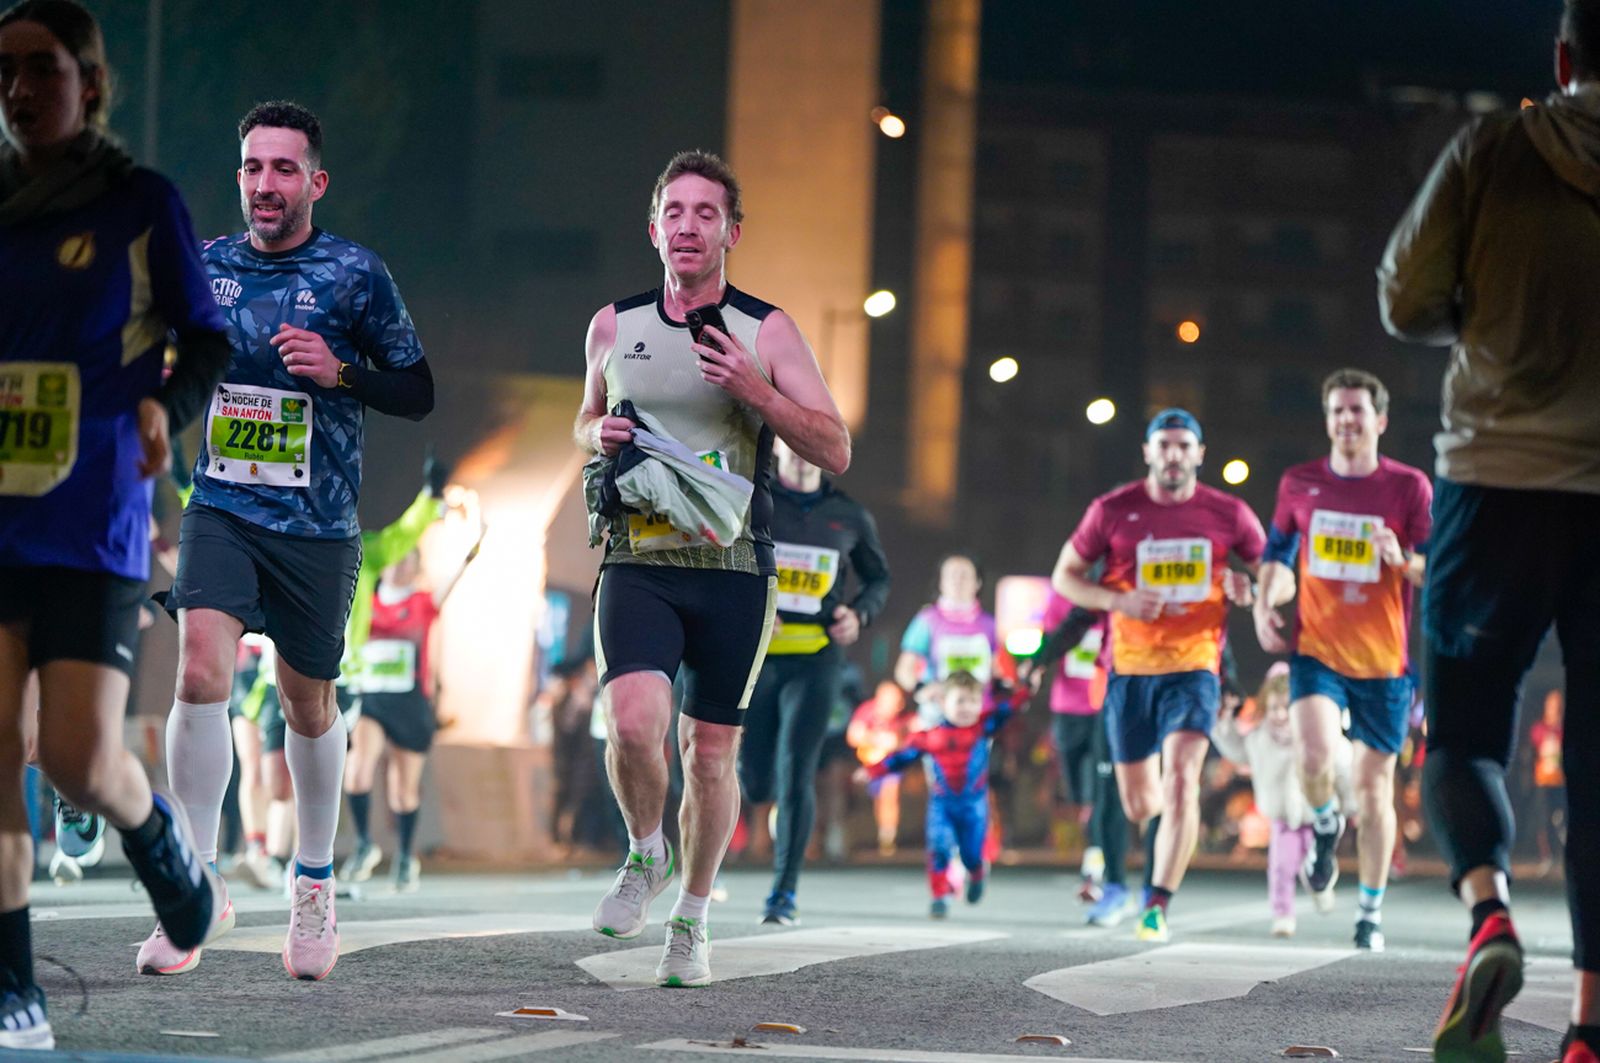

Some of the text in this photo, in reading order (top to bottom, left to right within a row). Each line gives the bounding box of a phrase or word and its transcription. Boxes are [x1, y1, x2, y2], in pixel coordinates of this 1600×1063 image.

[624, 353, 652, 361] VIATOR
[231, 395, 259, 407] NOCHE
[261, 398, 273, 408] DE
[221, 405, 239, 417] SAN
[239, 407, 272, 421] ANTÓN
[225, 419, 289, 453] 2281
[1324, 537, 1366, 559] 8189
[1153, 563, 1196, 580] 8190
